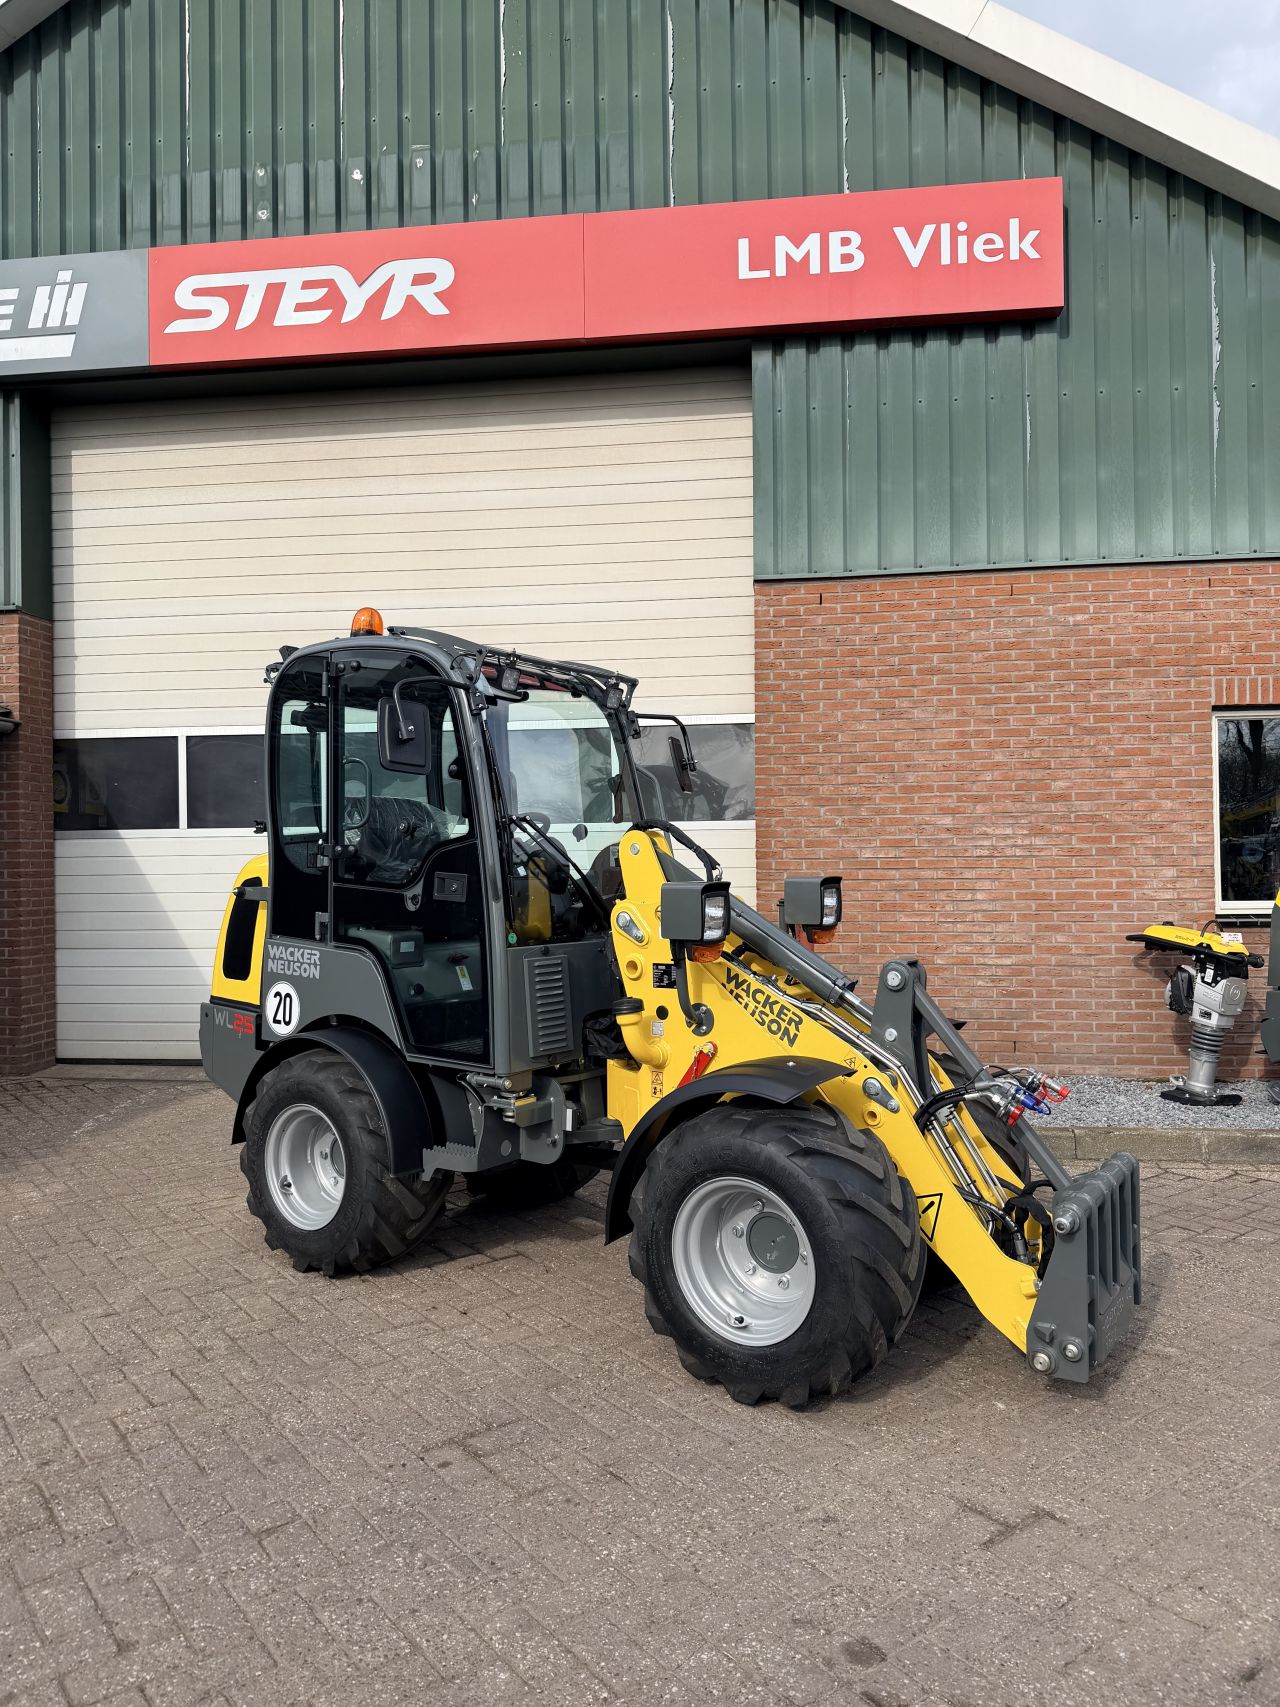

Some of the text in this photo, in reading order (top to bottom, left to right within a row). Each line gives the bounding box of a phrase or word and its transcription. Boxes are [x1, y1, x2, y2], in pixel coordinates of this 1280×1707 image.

[737, 217, 1042, 280] LMB Vliek
[164, 257, 456, 334] STEYR
[267, 944, 320, 965] WACKER
[267, 958, 320, 979] NEUSON
[273, 991, 293, 1026] 20
[721, 982, 799, 1048] EUSON
[726, 966, 804, 1034] WACKER
